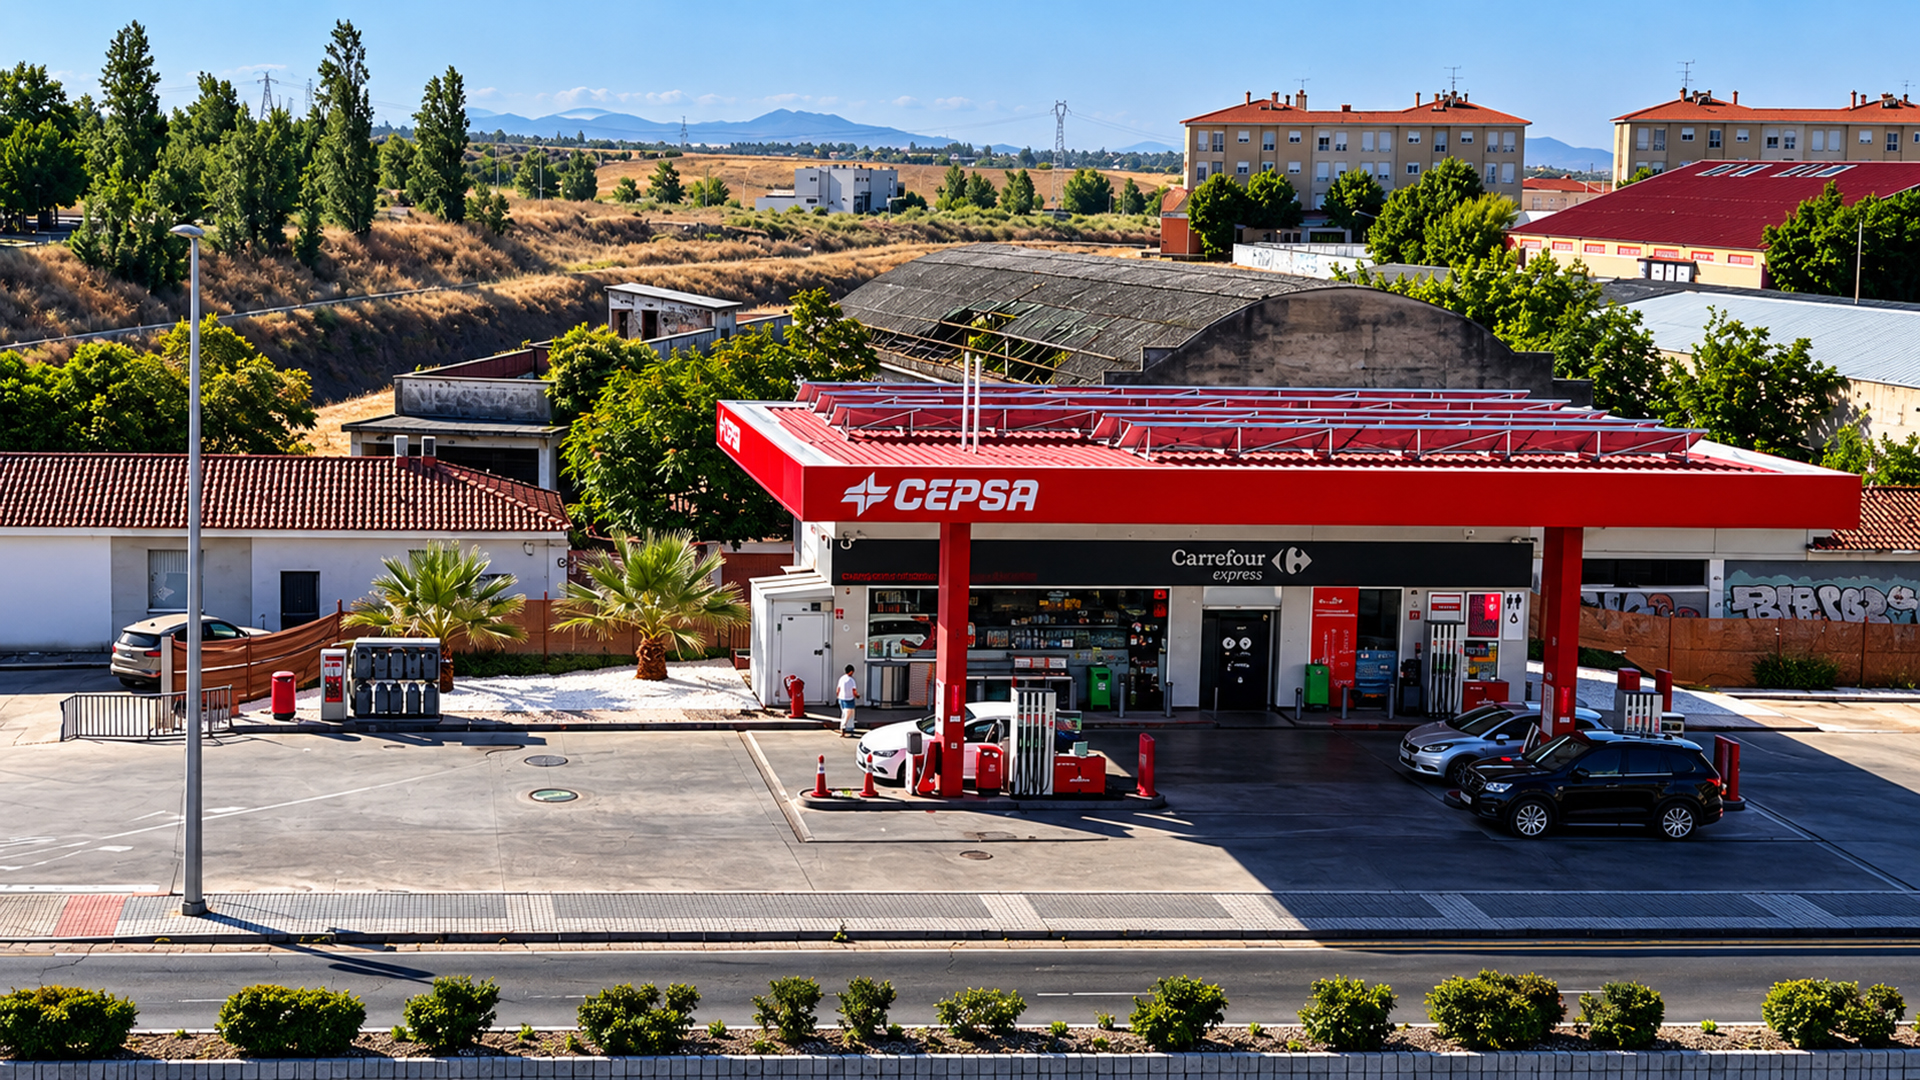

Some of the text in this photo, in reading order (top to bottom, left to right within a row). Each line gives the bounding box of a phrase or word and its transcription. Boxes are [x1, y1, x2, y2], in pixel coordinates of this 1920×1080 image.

[893, 478, 1040, 512] CEPSA
[1171, 547, 1266, 567] Carrefour
[1212, 569, 1263, 583] express
